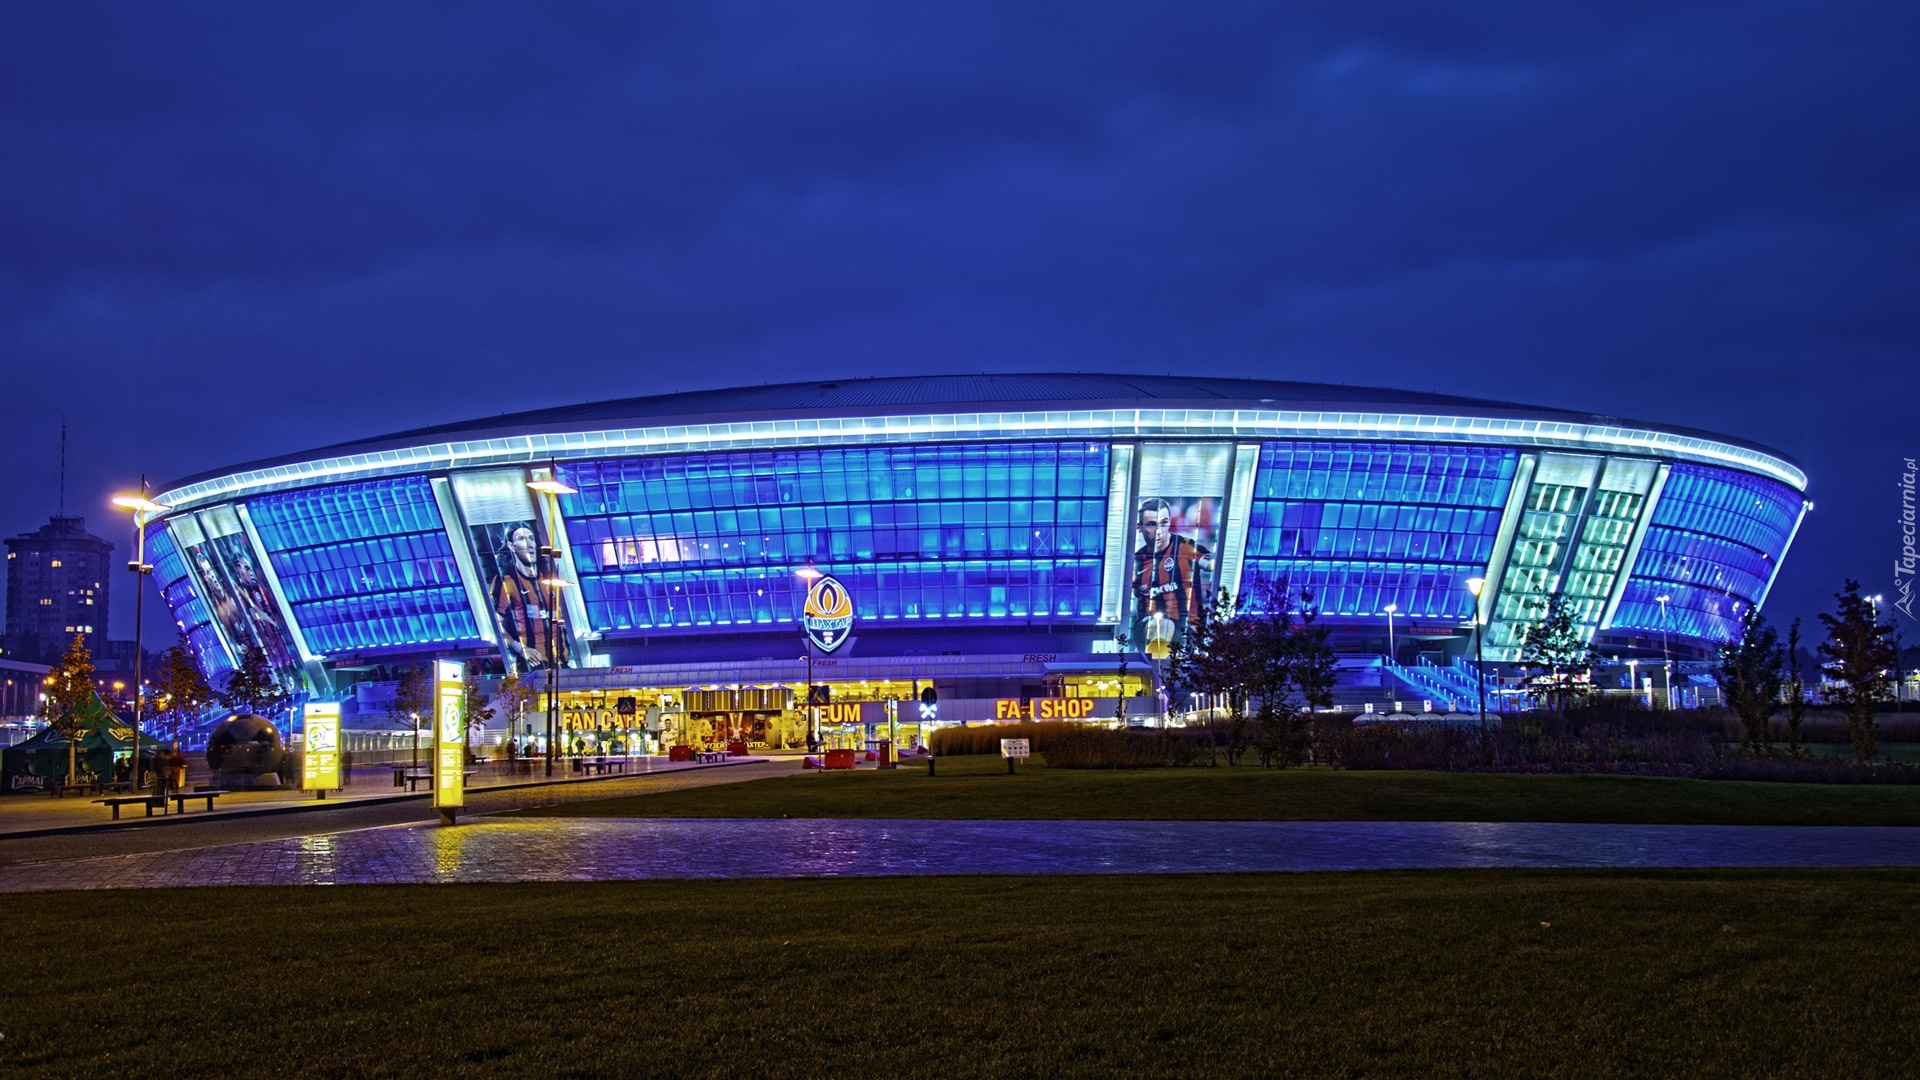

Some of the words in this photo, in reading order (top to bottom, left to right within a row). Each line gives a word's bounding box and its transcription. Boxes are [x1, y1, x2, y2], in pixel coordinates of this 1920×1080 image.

[812, 659, 837, 667] FRESH
[1023, 654, 1057, 663] FRESH
[1040, 698, 1094, 718] SHOP
[562, 711, 597, 730] FAN
